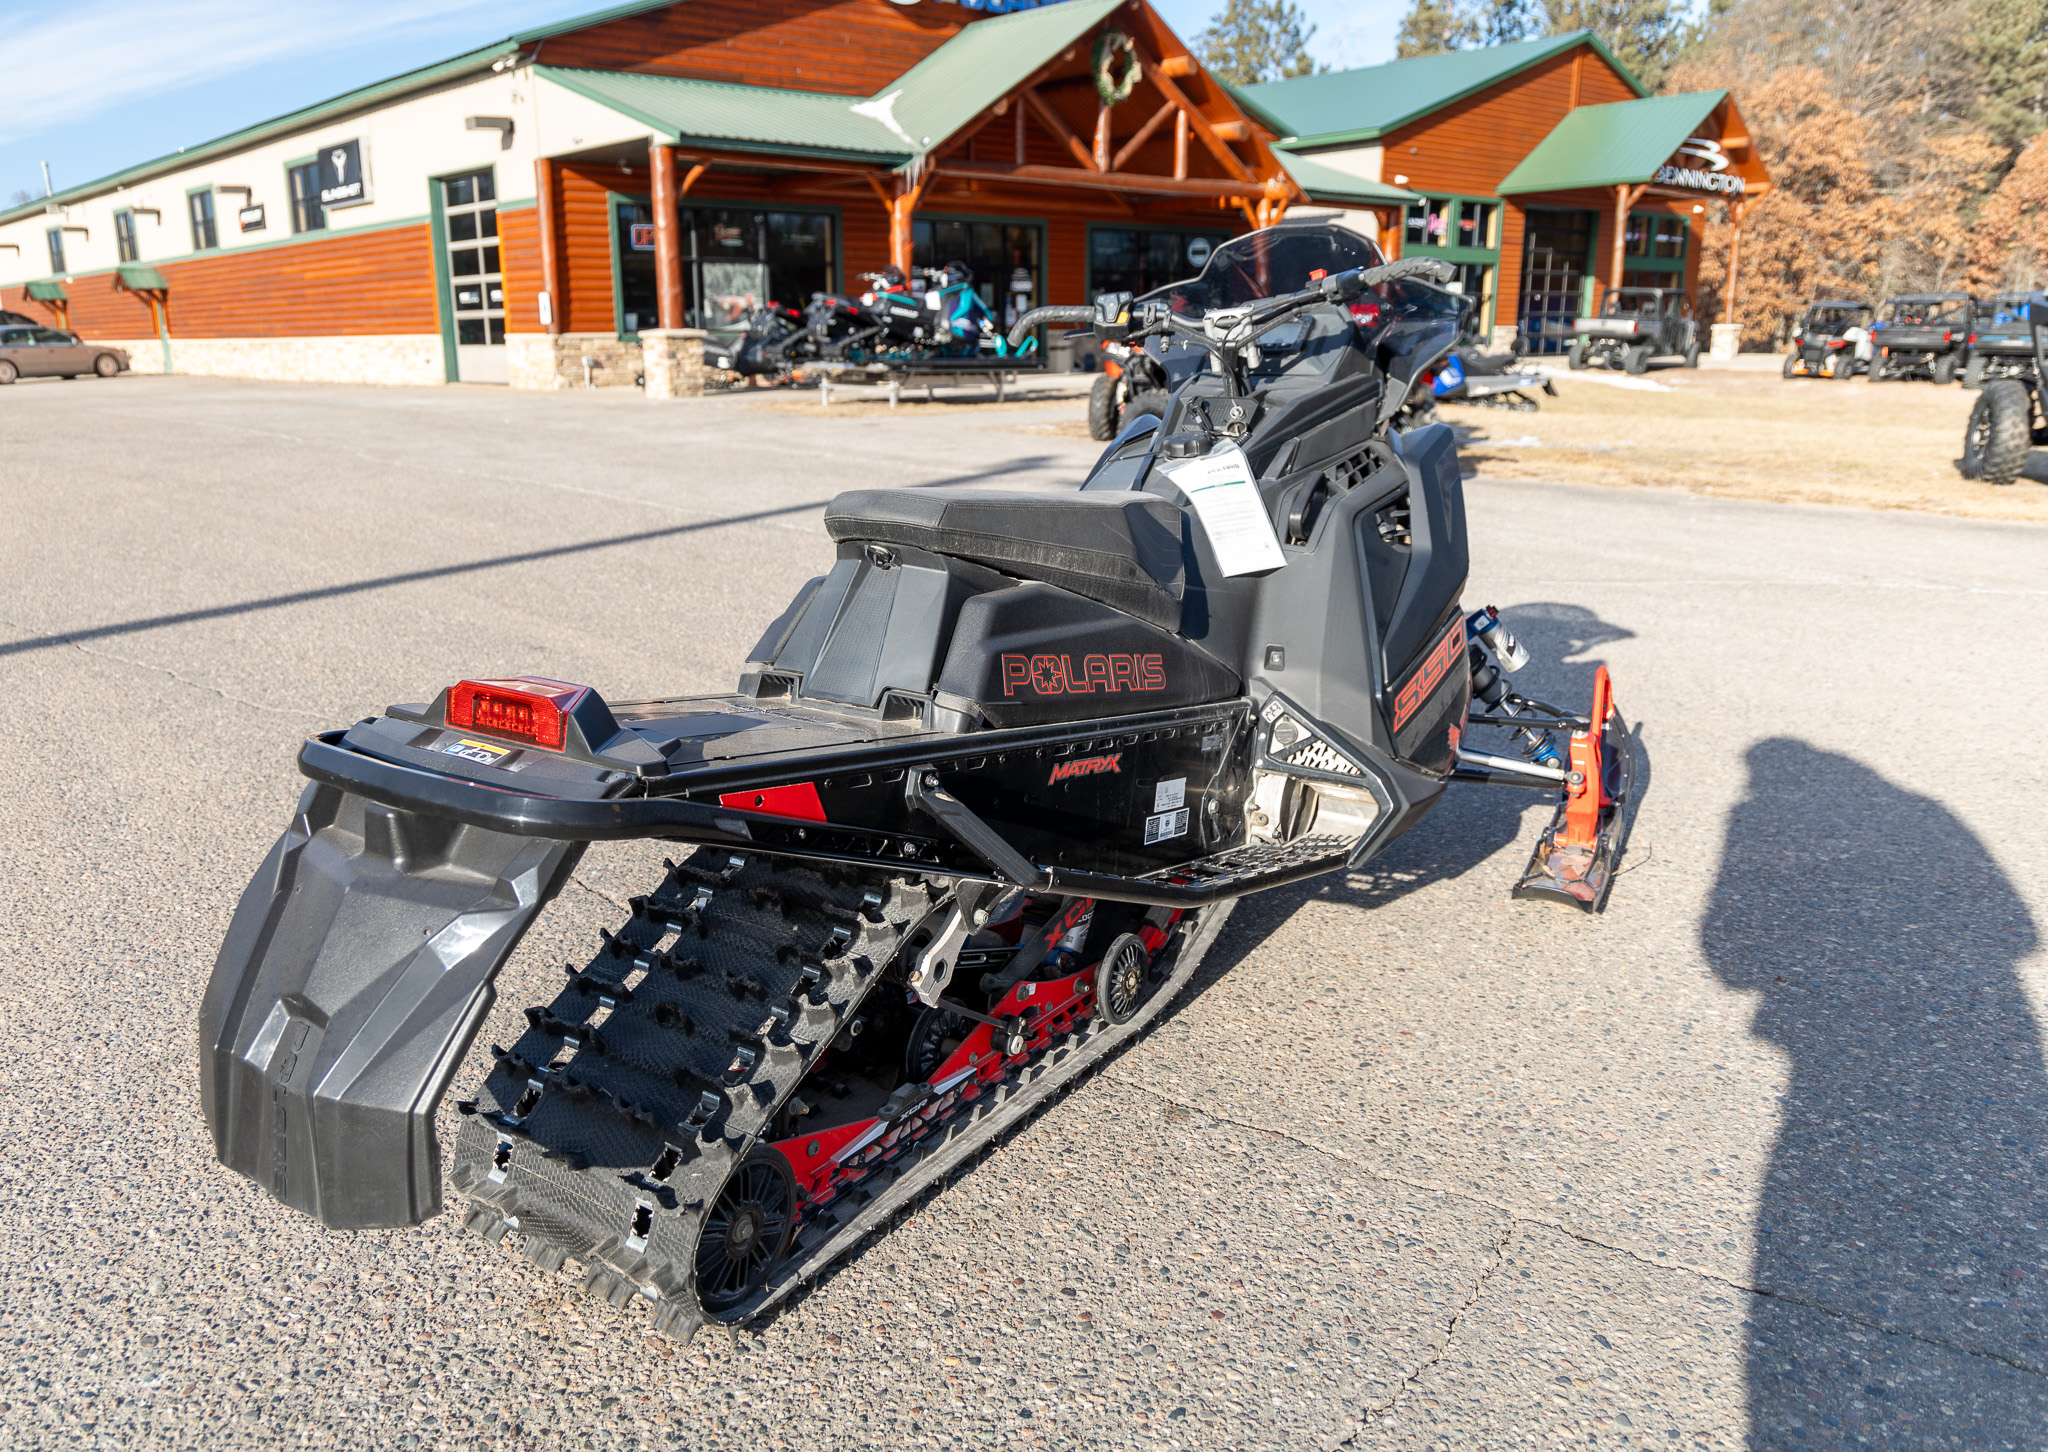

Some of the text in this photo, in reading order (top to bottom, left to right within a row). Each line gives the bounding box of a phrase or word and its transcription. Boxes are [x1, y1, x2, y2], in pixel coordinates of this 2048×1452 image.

[1655, 165, 1746, 193] BENNINGTON
[1002, 653, 1167, 697] POLARIS
[1393, 615, 1467, 735] 850
[1047, 752, 1124, 786] MATRYX
[898, 1098, 928, 1123] XCR
